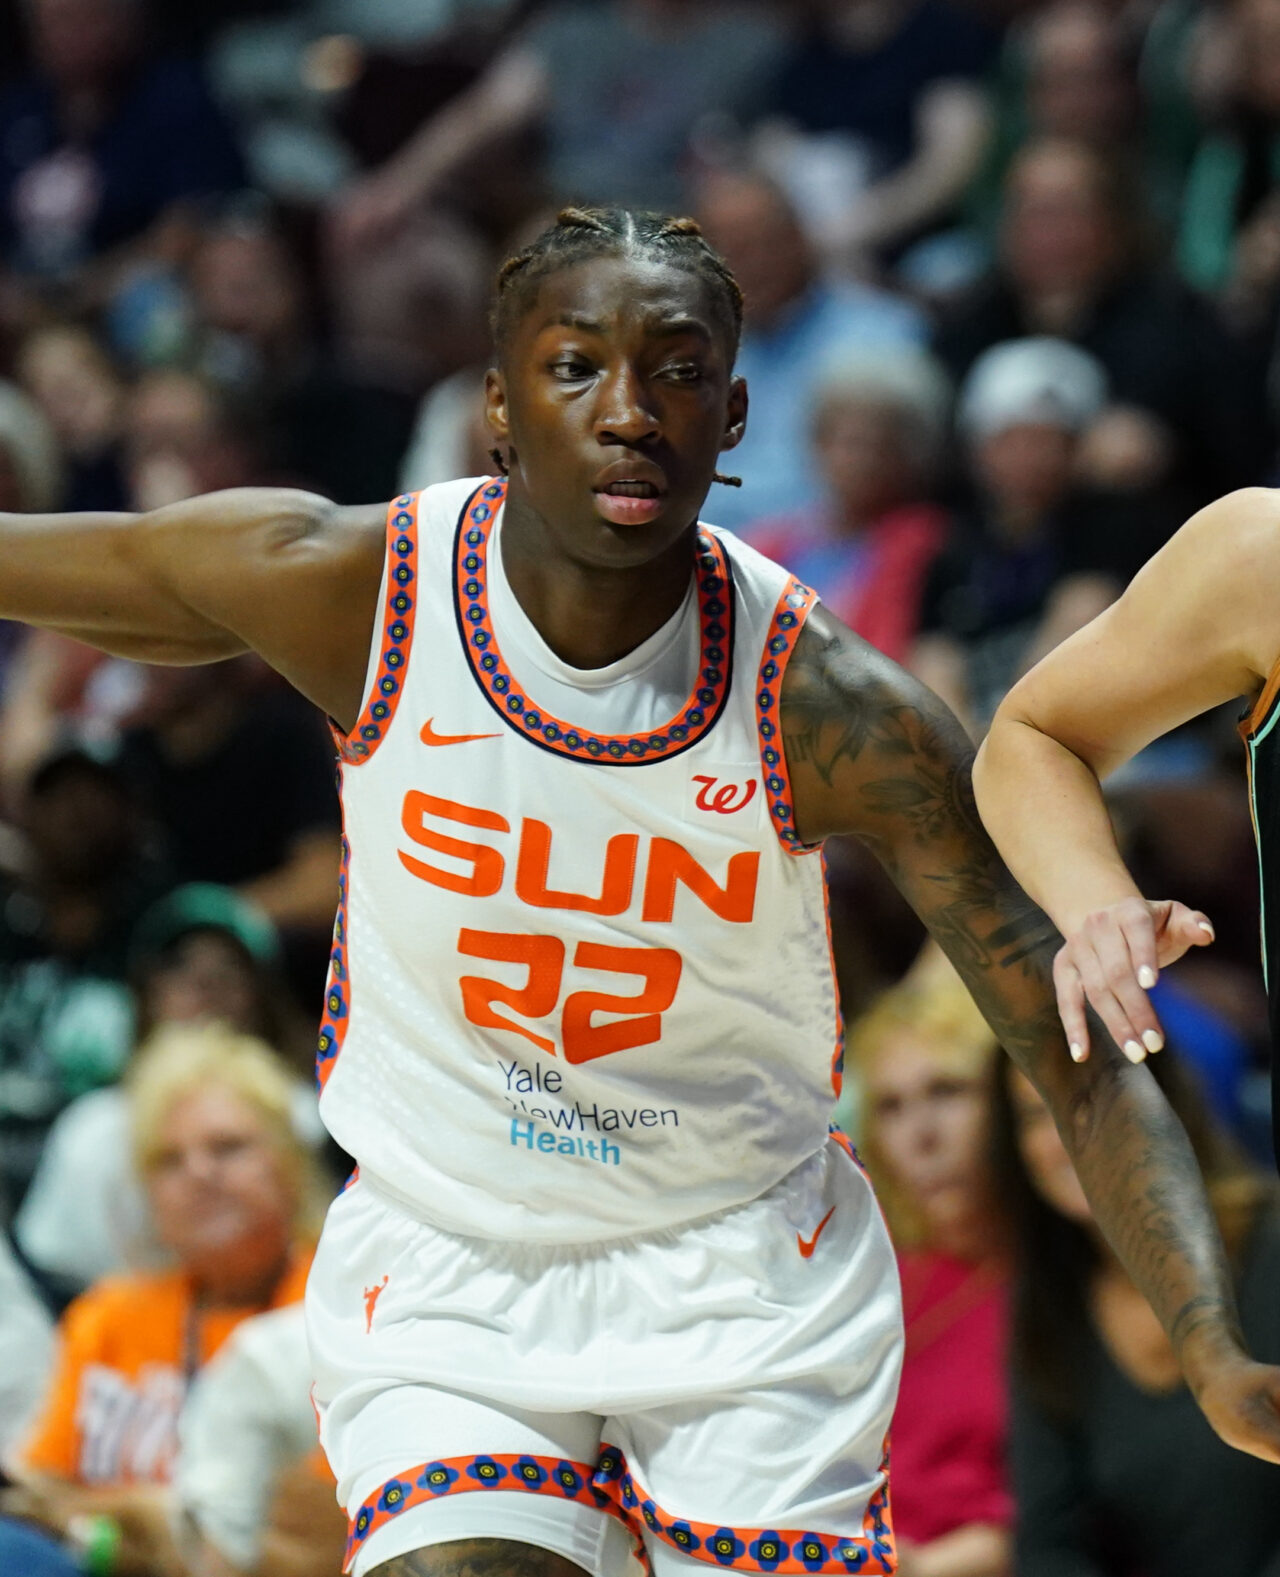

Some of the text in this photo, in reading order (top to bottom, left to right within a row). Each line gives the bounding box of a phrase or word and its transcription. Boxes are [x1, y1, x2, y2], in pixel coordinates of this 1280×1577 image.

[397, 789, 761, 923] SUN
[456, 927, 683, 1066] 22
[498, 1060, 563, 1093] Yale
[510, 1117, 621, 1166] Health
